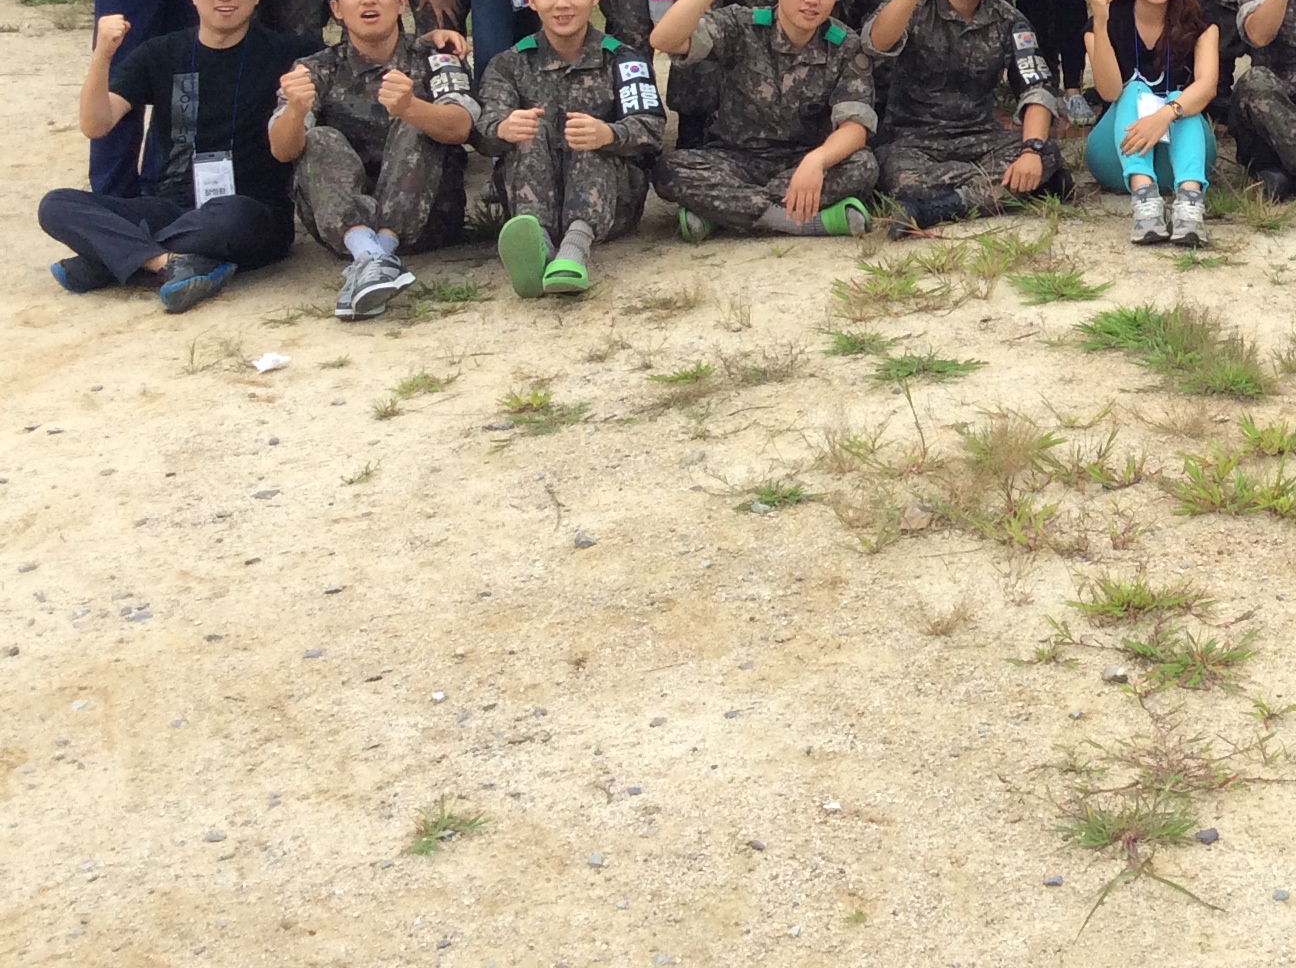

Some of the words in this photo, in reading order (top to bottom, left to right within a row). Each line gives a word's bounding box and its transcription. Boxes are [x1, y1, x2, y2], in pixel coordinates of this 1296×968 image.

[619, 82, 658, 103] 헌병
[178, 79, 191, 147] Lovng
[622, 99, 660, 114] MP
